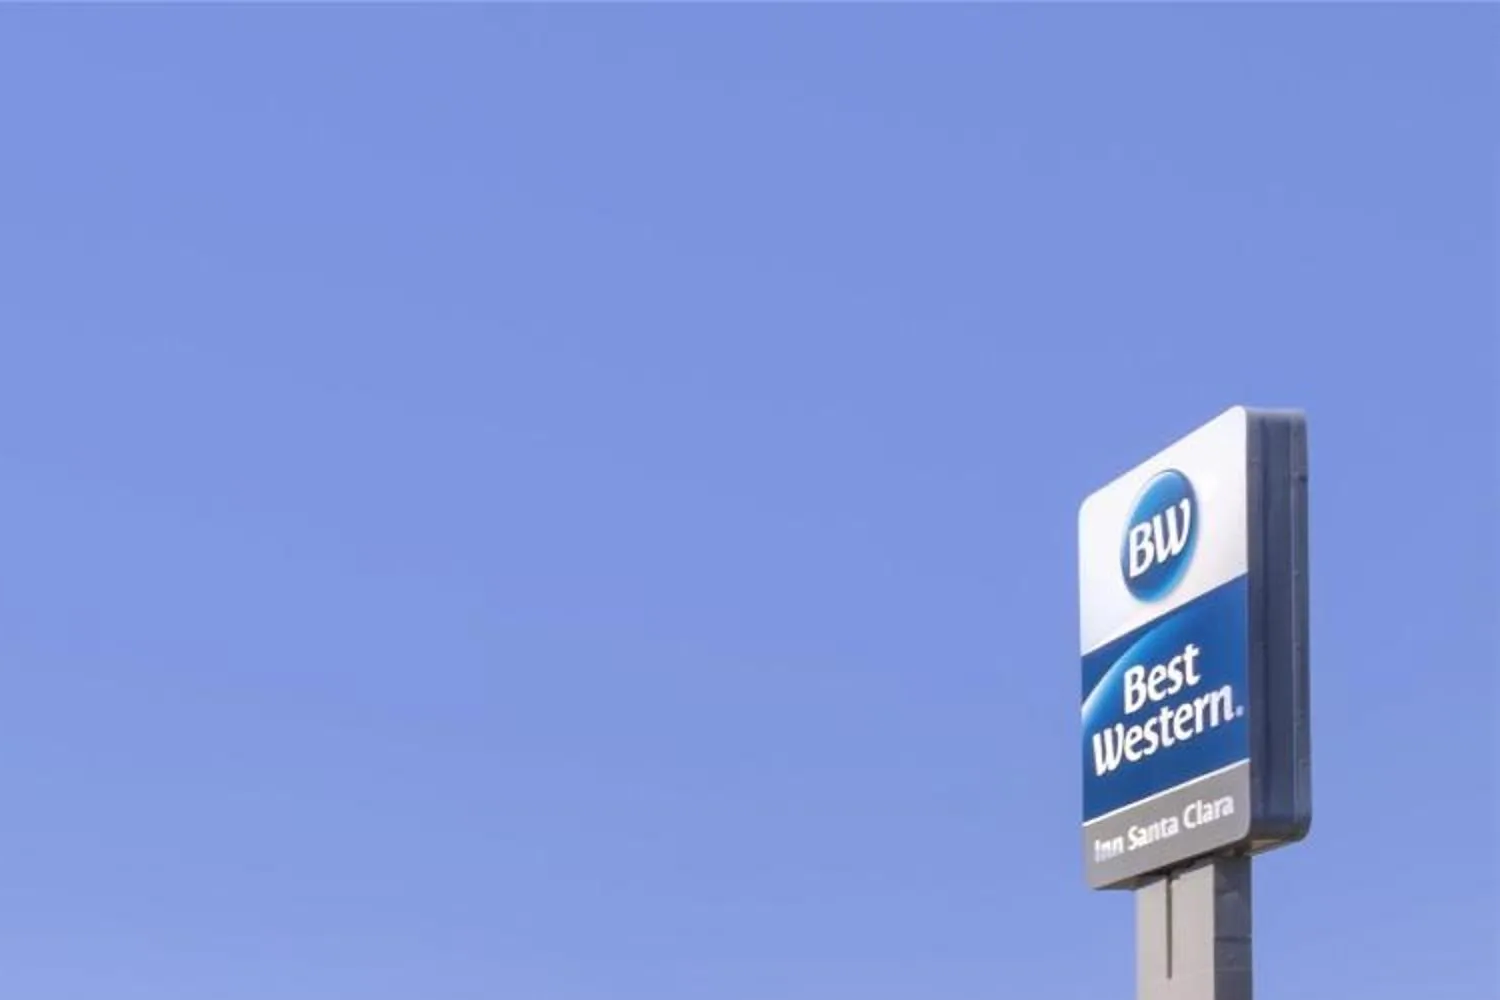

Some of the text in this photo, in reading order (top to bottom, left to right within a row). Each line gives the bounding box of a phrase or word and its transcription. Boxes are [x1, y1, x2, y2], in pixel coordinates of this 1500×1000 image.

[1129, 498, 1191, 578] BW
[1124, 643, 1200, 715] Best
[1094, 796, 1234, 863] Inn Santa Clara
